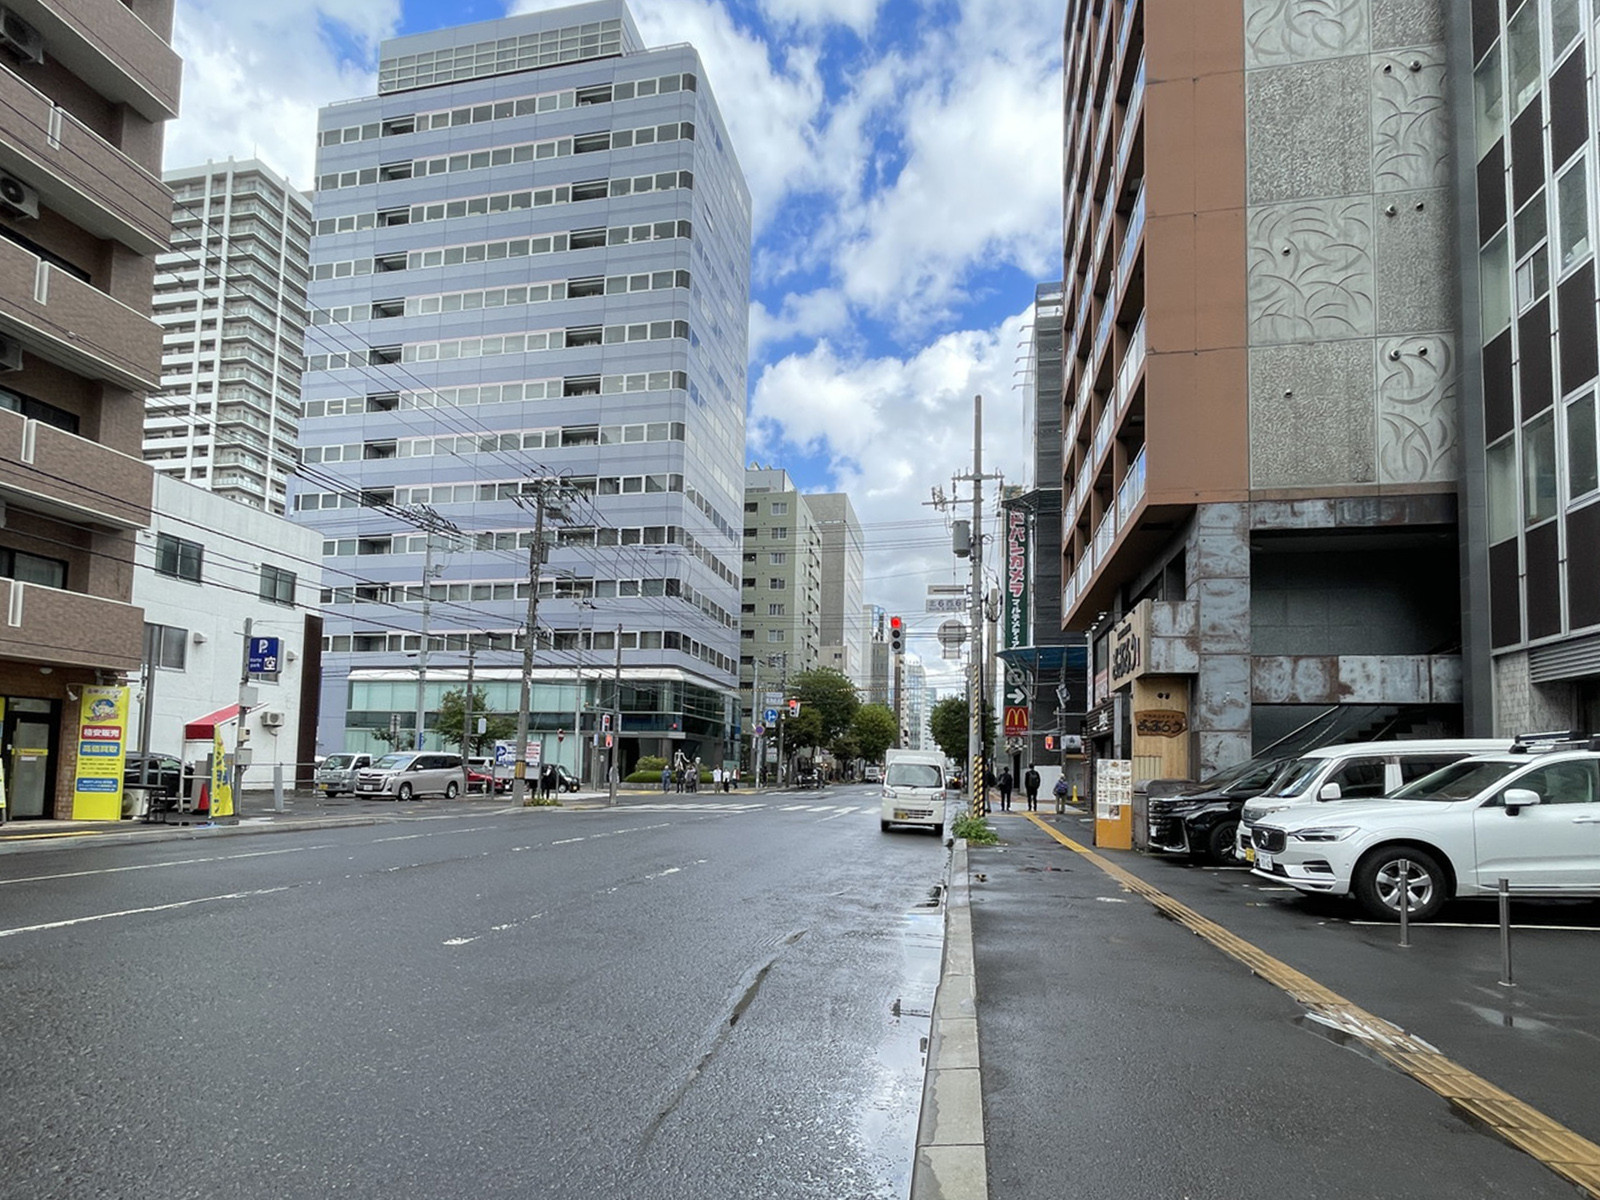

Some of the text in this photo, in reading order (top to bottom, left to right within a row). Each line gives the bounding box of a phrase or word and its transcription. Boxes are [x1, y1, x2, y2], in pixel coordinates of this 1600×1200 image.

[1009, 508, 1024, 597] ドバシカメラ
[259, 639, 268, 653] P
